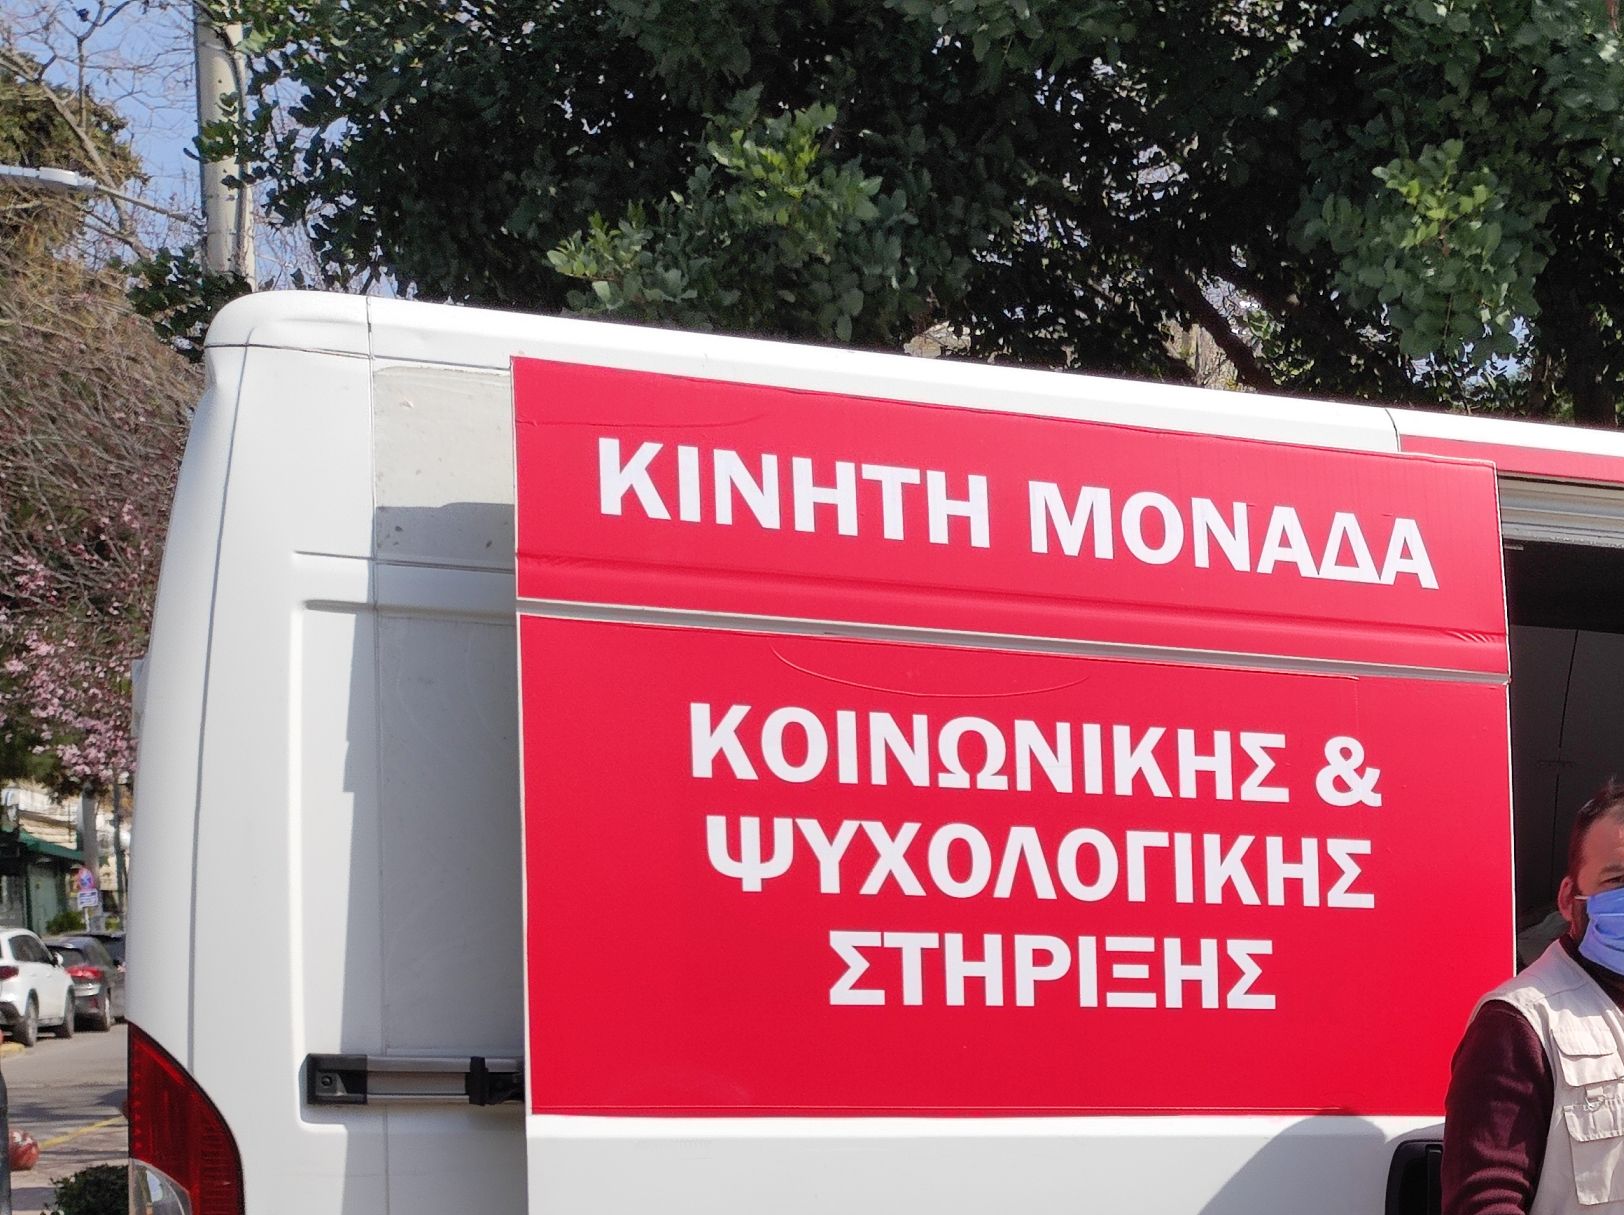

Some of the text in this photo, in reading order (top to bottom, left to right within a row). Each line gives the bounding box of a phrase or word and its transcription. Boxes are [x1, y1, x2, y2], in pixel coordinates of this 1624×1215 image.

[597, 437, 1440, 591] ΚΙΝΗΤΗ ΜΟΝΑΔΑ
[688, 702, 1383, 809] ΚΟΙΝΩΝΙΚΗΣ &
[705, 814, 1377, 910] ΨΥΧΟΛΟΓΙΚΗΣ
[828, 930, 1278, 1011] ΣΤΗΡΙΞΗΣ
